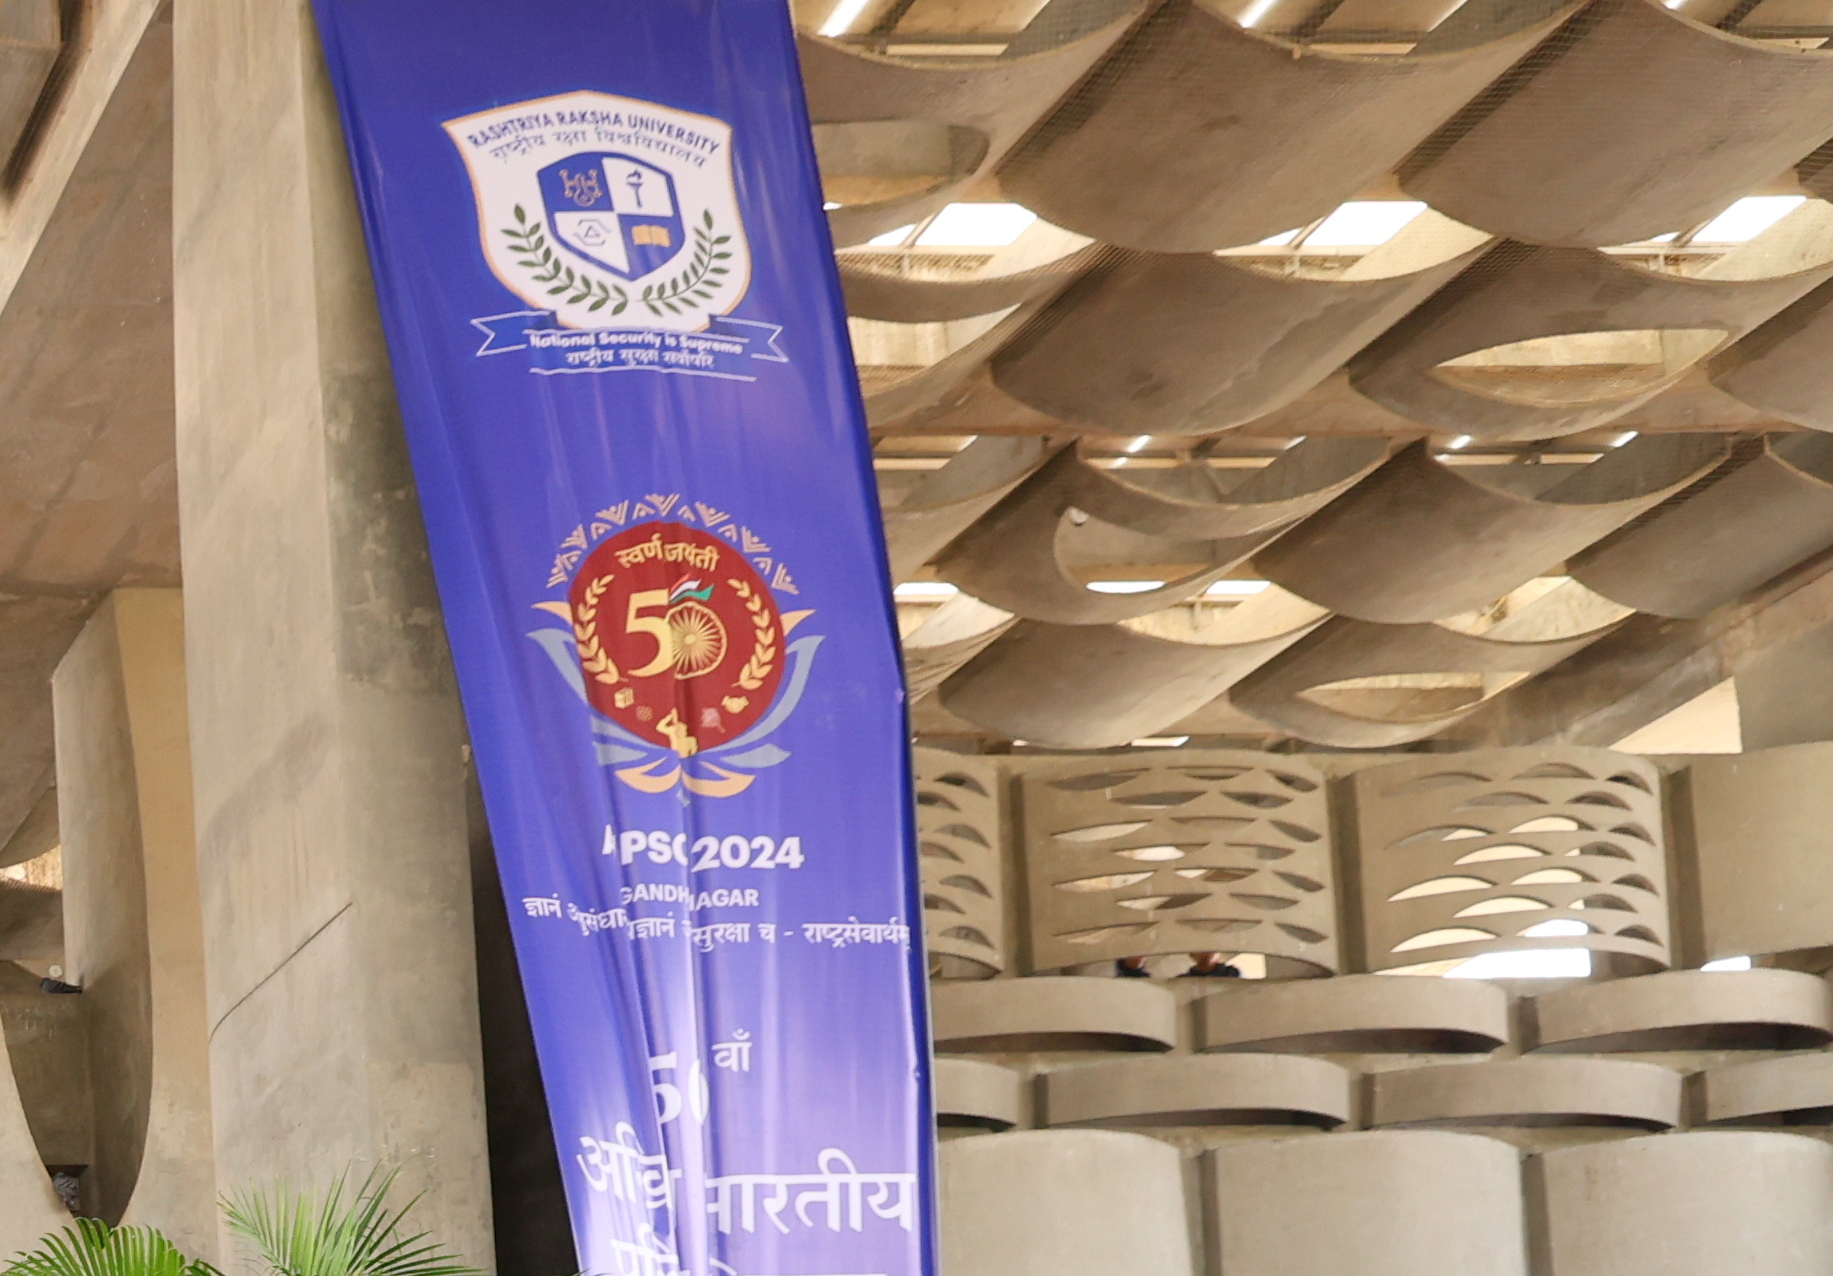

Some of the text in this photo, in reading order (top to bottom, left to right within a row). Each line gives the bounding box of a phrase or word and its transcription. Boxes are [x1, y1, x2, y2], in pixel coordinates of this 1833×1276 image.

[466, 109, 721, 154] RASHTRIYA RAKSHA UNIVERSITY
[529, 331, 744, 355] National Security is Supreme
[614, 533, 664, 569] स्वर्ण
[691, 836, 805, 873] 2024
[758, 923, 777, 943] च
